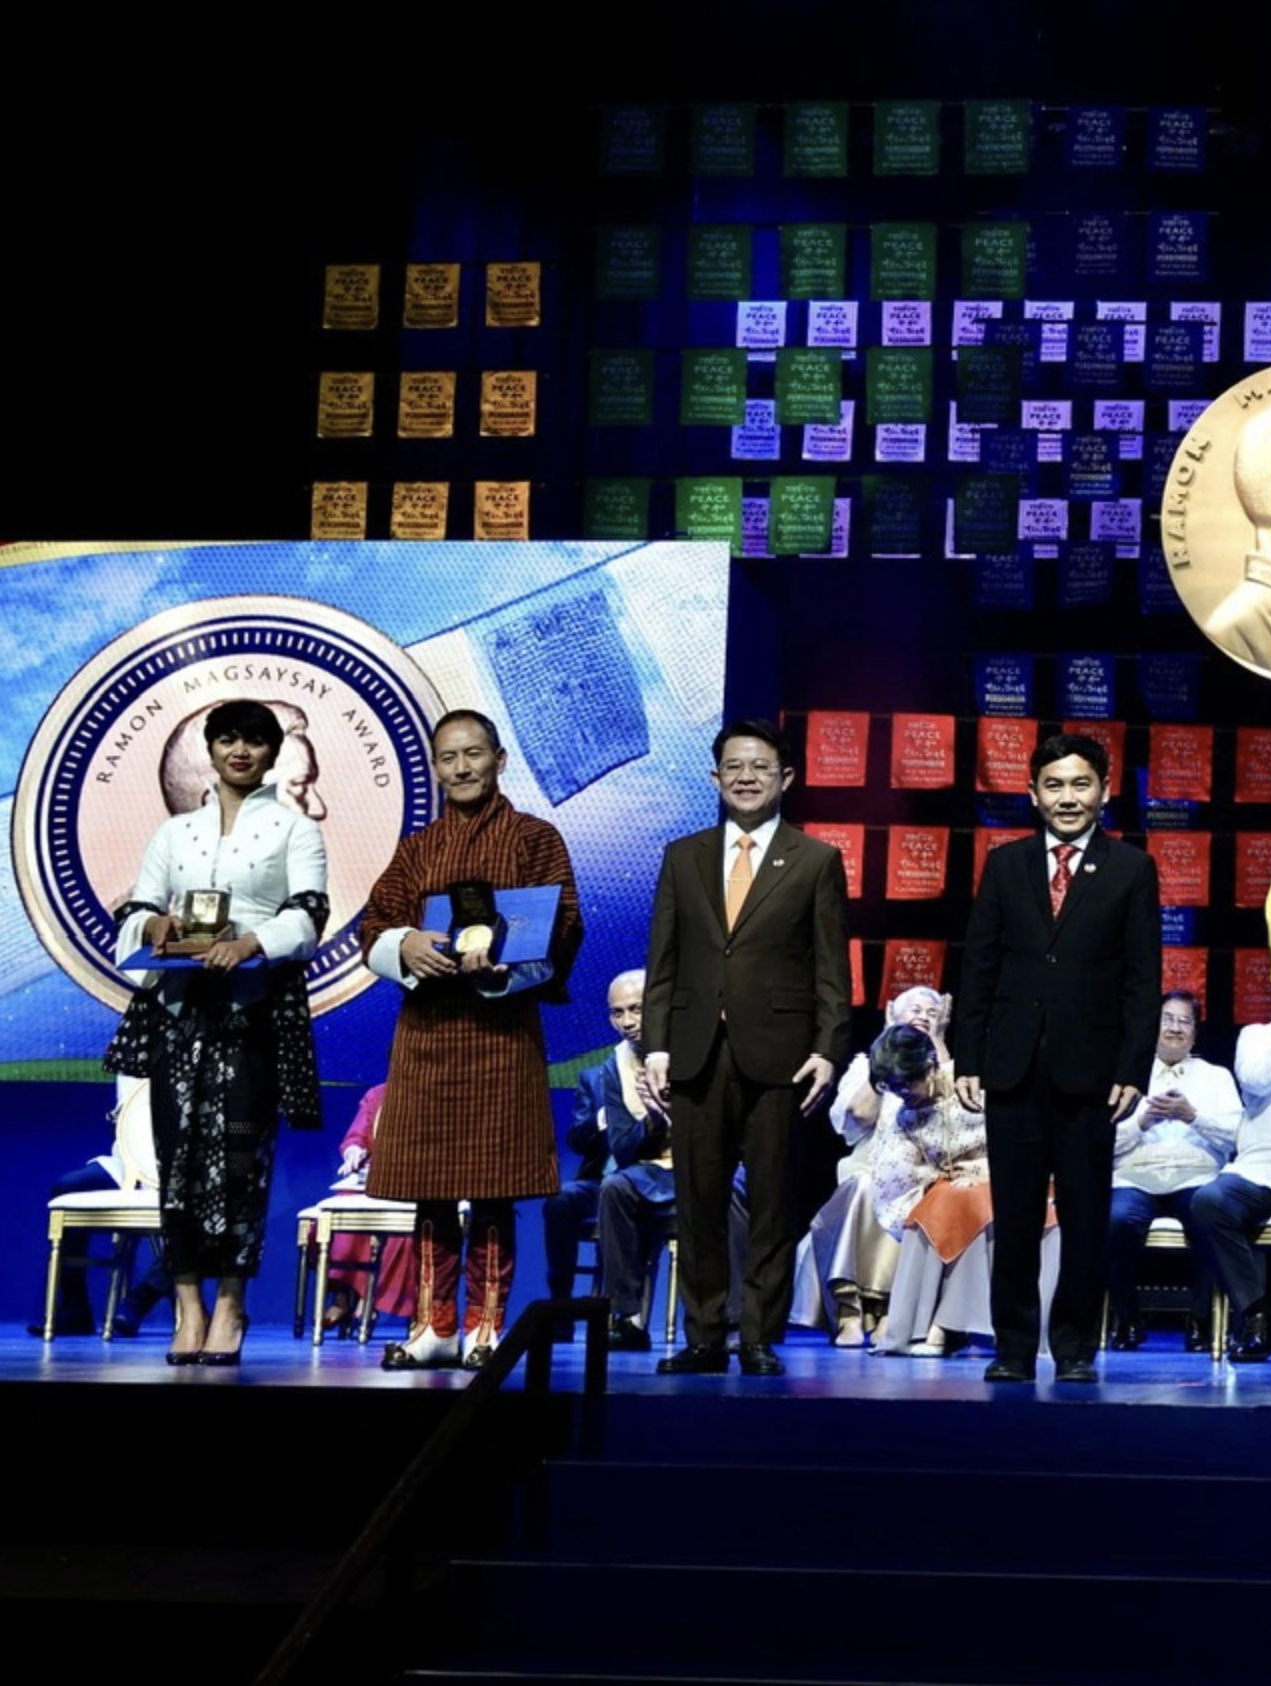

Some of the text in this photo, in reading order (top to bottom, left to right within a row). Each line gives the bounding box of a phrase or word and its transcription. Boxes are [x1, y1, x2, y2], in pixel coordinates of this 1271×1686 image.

[796, 117, 836, 126] PEACE
[887, 116, 927, 125] PEACE
[978, 114, 1018, 123] PEACE
[1159, 120, 1195, 128] PEACE
[1158, 227, 1194, 235] PEACE
[699, 242, 738, 250] PEACE
[793, 238, 833, 247] PEACE
[883, 241, 923, 250] PEACE
[975, 238, 1015, 247] PEACE
[496, 275, 532, 283] PEACE
[816, 312, 848, 320] PEACE
[889, 312, 922, 320] PEACE
[1077, 333, 1113, 343] PEACE
[1155, 336, 1191, 345] PEACE
[694, 365, 734, 374] PEACE
[790, 364, 830, 372] PEACE
[878, 364, 918, 372] PEACE
[328, 385, 364, 393] PEACE
[408, 385, 444, 393] PEACE
[491, 384, 527, 392] PEACE
[1072, 444, 1108, 453] PEACE
[322, 493, 358, 502] PEACE
[401, 494, 437, 502] PEACE
[484, 494, 520, 502] PEACE
[596, 496, 635, 504] PEACE
[690, 494, 730, 503] PEACE
[781, 494, 821, 503] PEACE
[1167, 437, 1212, 573] RAMON
[1026, 510, 1058, 518] PEACE
[985, 667, 1021, 675] PEACE
[1069, 667, 1104, 676] PEACE
[97, 664, 390, 789] RAMON MAGSAYSAY AWARD
[820, 728, 856, 736] PEACE
[904, 731, 941, 739] PEACE
[987, 733, 1024, 742] PEACE
[1161, 741, 1198, 749] PEACE
[902, 842, 938, 851] PEACE
[895, 955, 932, 963] PEACE
